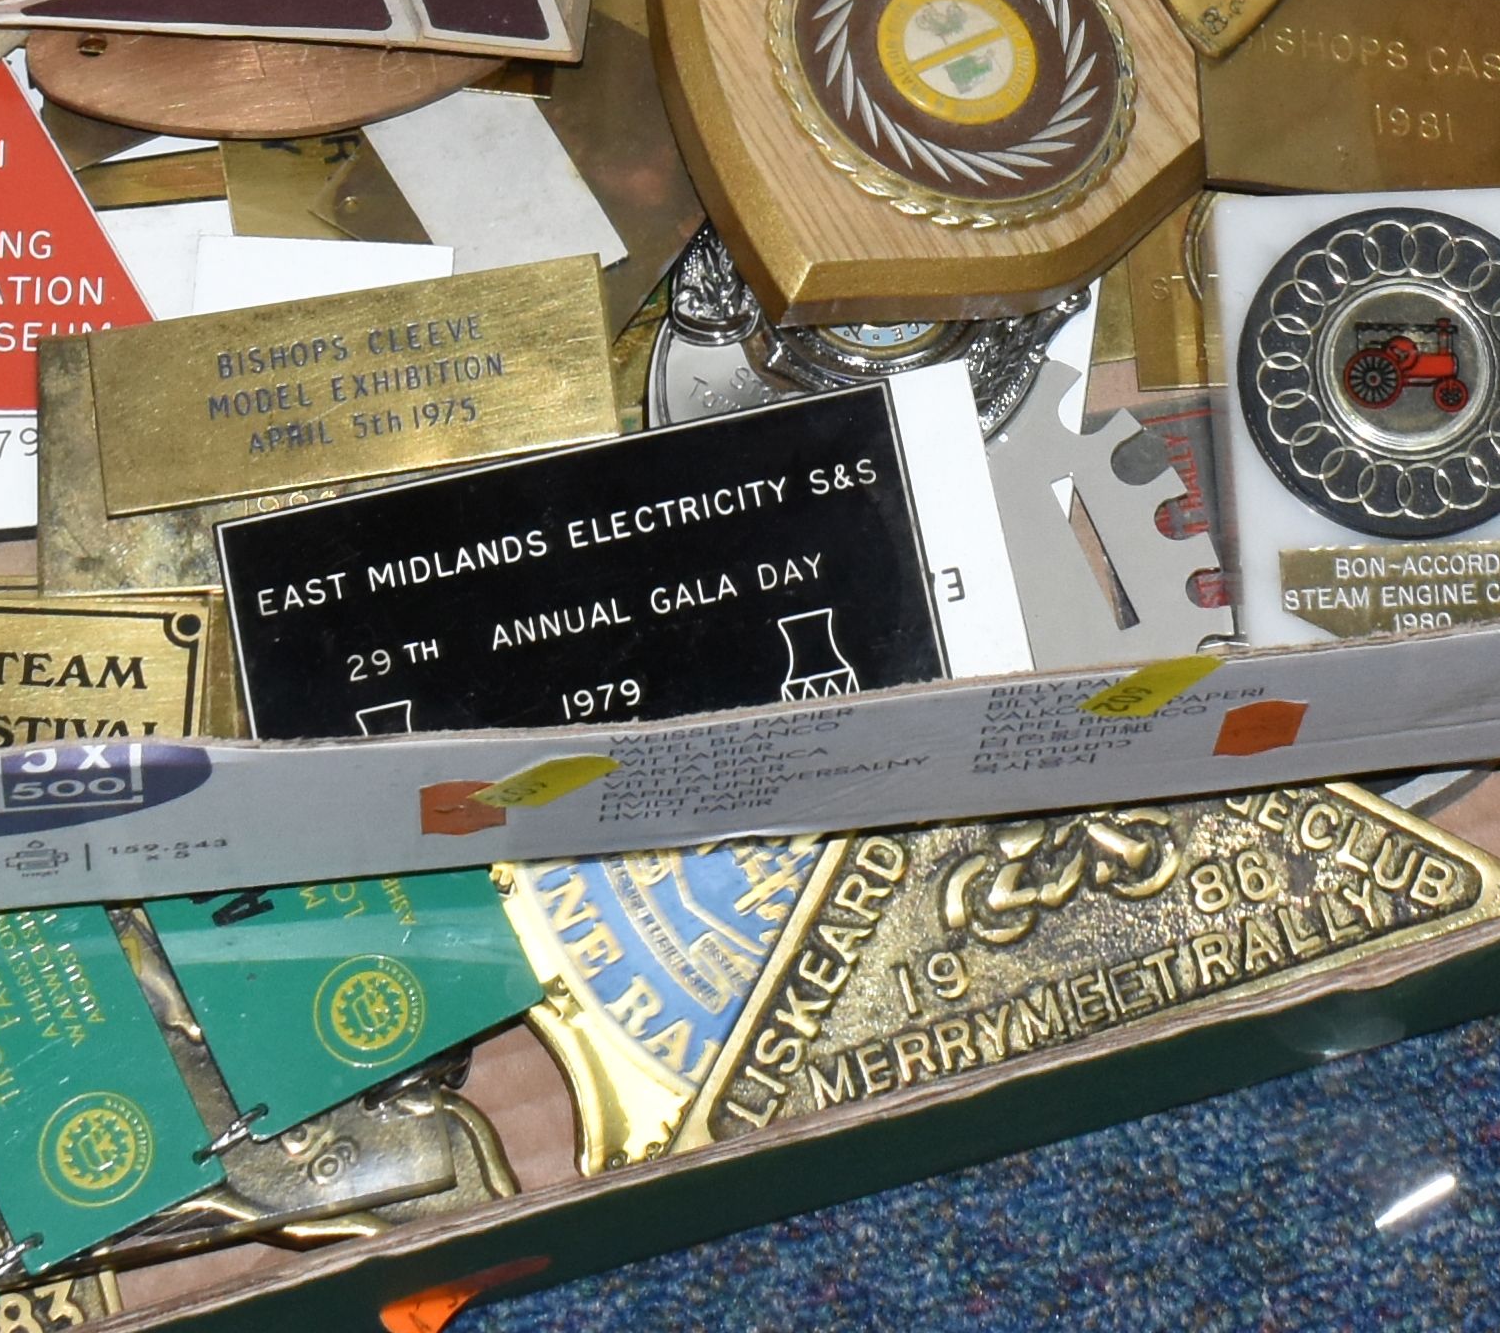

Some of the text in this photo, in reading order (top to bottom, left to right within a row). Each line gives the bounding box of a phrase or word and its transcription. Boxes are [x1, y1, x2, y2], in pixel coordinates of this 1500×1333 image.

[1375, 104, 1453, 142] 1981
[217, 314, 483, 380] BISHOPS CLEEVE
[208, 353, 506, 420] MODEL EXHIBITION
[249, 397, 476, 453] APRIL 5th 1975
[256, 459, 878, 618] EAST MIDLANDS ELECTRICITY S&S
[348, 553, 825, 681] 29 TH ANNUAL GALA DAY
[1284, 588, 1370, 611] STEAM
[1381, 583, 1476, 606] ENGINE
[1393, 612, 1450, 633] 1980
[561, 679, 642, 721] 1979
[710, 721, 840, 747] BLANCO
[11, 776, 127, 800] 500
[712, 756, 930, 791] UNIWERSALNY
[1297, 805, 1458, 906] CLUB
[1188, 857, 1275, 914] 86
[725, 837, 906, 1127] LISKEARD
[807, 882, 1379, 1110] MERRYMEET RALLY
[898, 951, 968, 1014] 19
